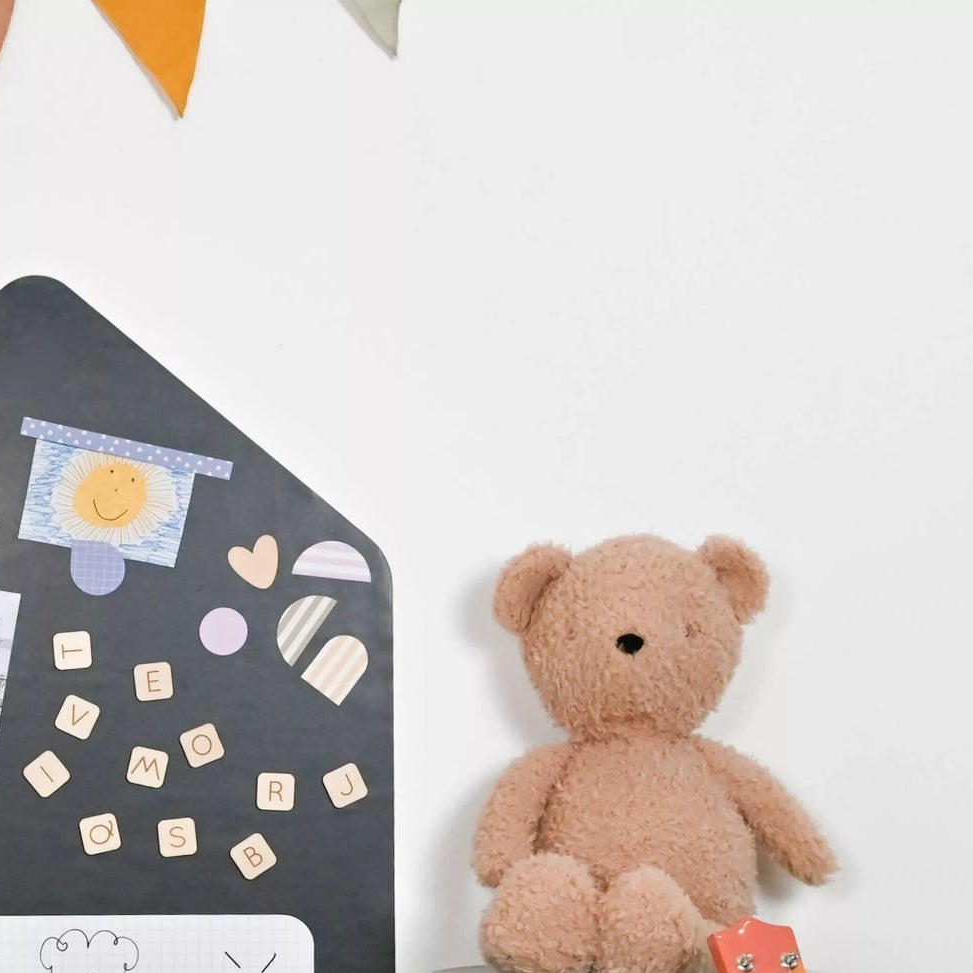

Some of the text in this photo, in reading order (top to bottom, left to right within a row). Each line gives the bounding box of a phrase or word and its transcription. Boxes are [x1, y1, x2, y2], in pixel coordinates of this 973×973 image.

[61, 643, 83, 660] T
[146, 670, 162, 693] E
[71, 703, 90, 727] V
[191, 734, 213, 756] O
[130, 755, 161, 782] M
[268, 780, 284, 802] R
[339, 773, 355, 797] J
[88, 819, 115, 845] Q
[168, 826, 187, 848] S
[242, 845, 264, 868] B
